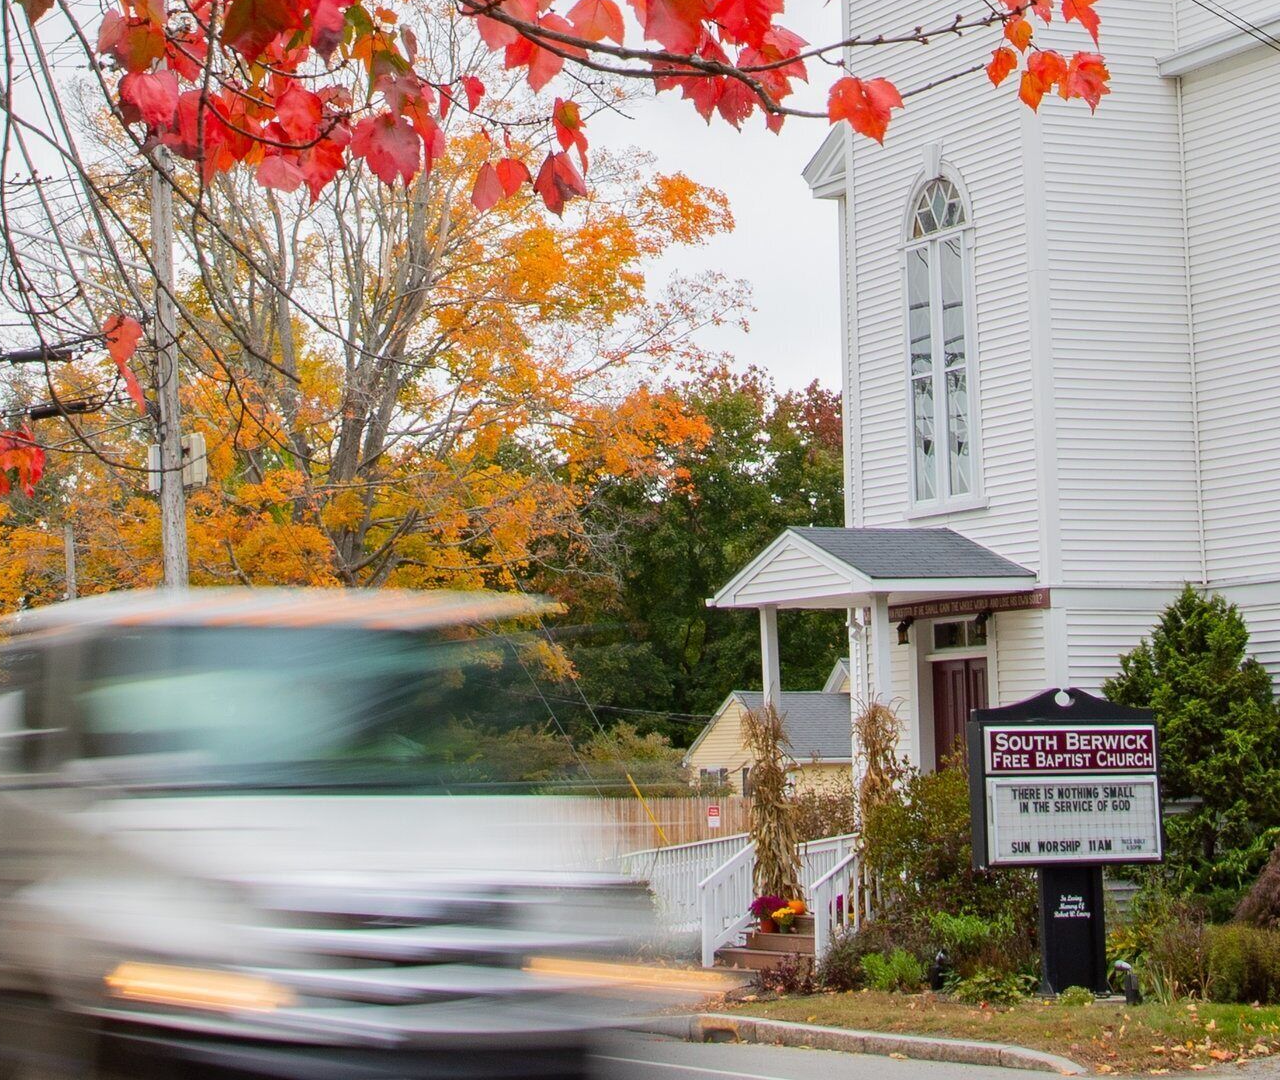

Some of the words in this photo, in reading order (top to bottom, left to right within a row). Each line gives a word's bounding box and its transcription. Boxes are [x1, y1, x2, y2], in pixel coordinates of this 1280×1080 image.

[995, 733, 1058, 751] SOUTH
[1065, 732, 1149, 750] BERWICK
[992, 751, 1030, 768] FREE
[1035, 751, 1091, 768] BAPTIST
[1096, 750, 1153, 767] CHURCH
[1011, 788, 1041, 800] THERE
[1044, 788, 1054, 800] IS
[1057, 787, 1099, 799] NOTHING
[1103, 786, 1135, 798] SMALL
[1019, 801, 1029, 813] IN
[1032, 801, 1050, 813] THE
[1054, 800, 1093, 812] SERVICE
[1097, 800, 1108, 811] OF
[1111, 799, 1131, 811] GOD
[1011, 841, 1031, 854] SUN
[1037, 840, 1081, 853] WORSHIP
